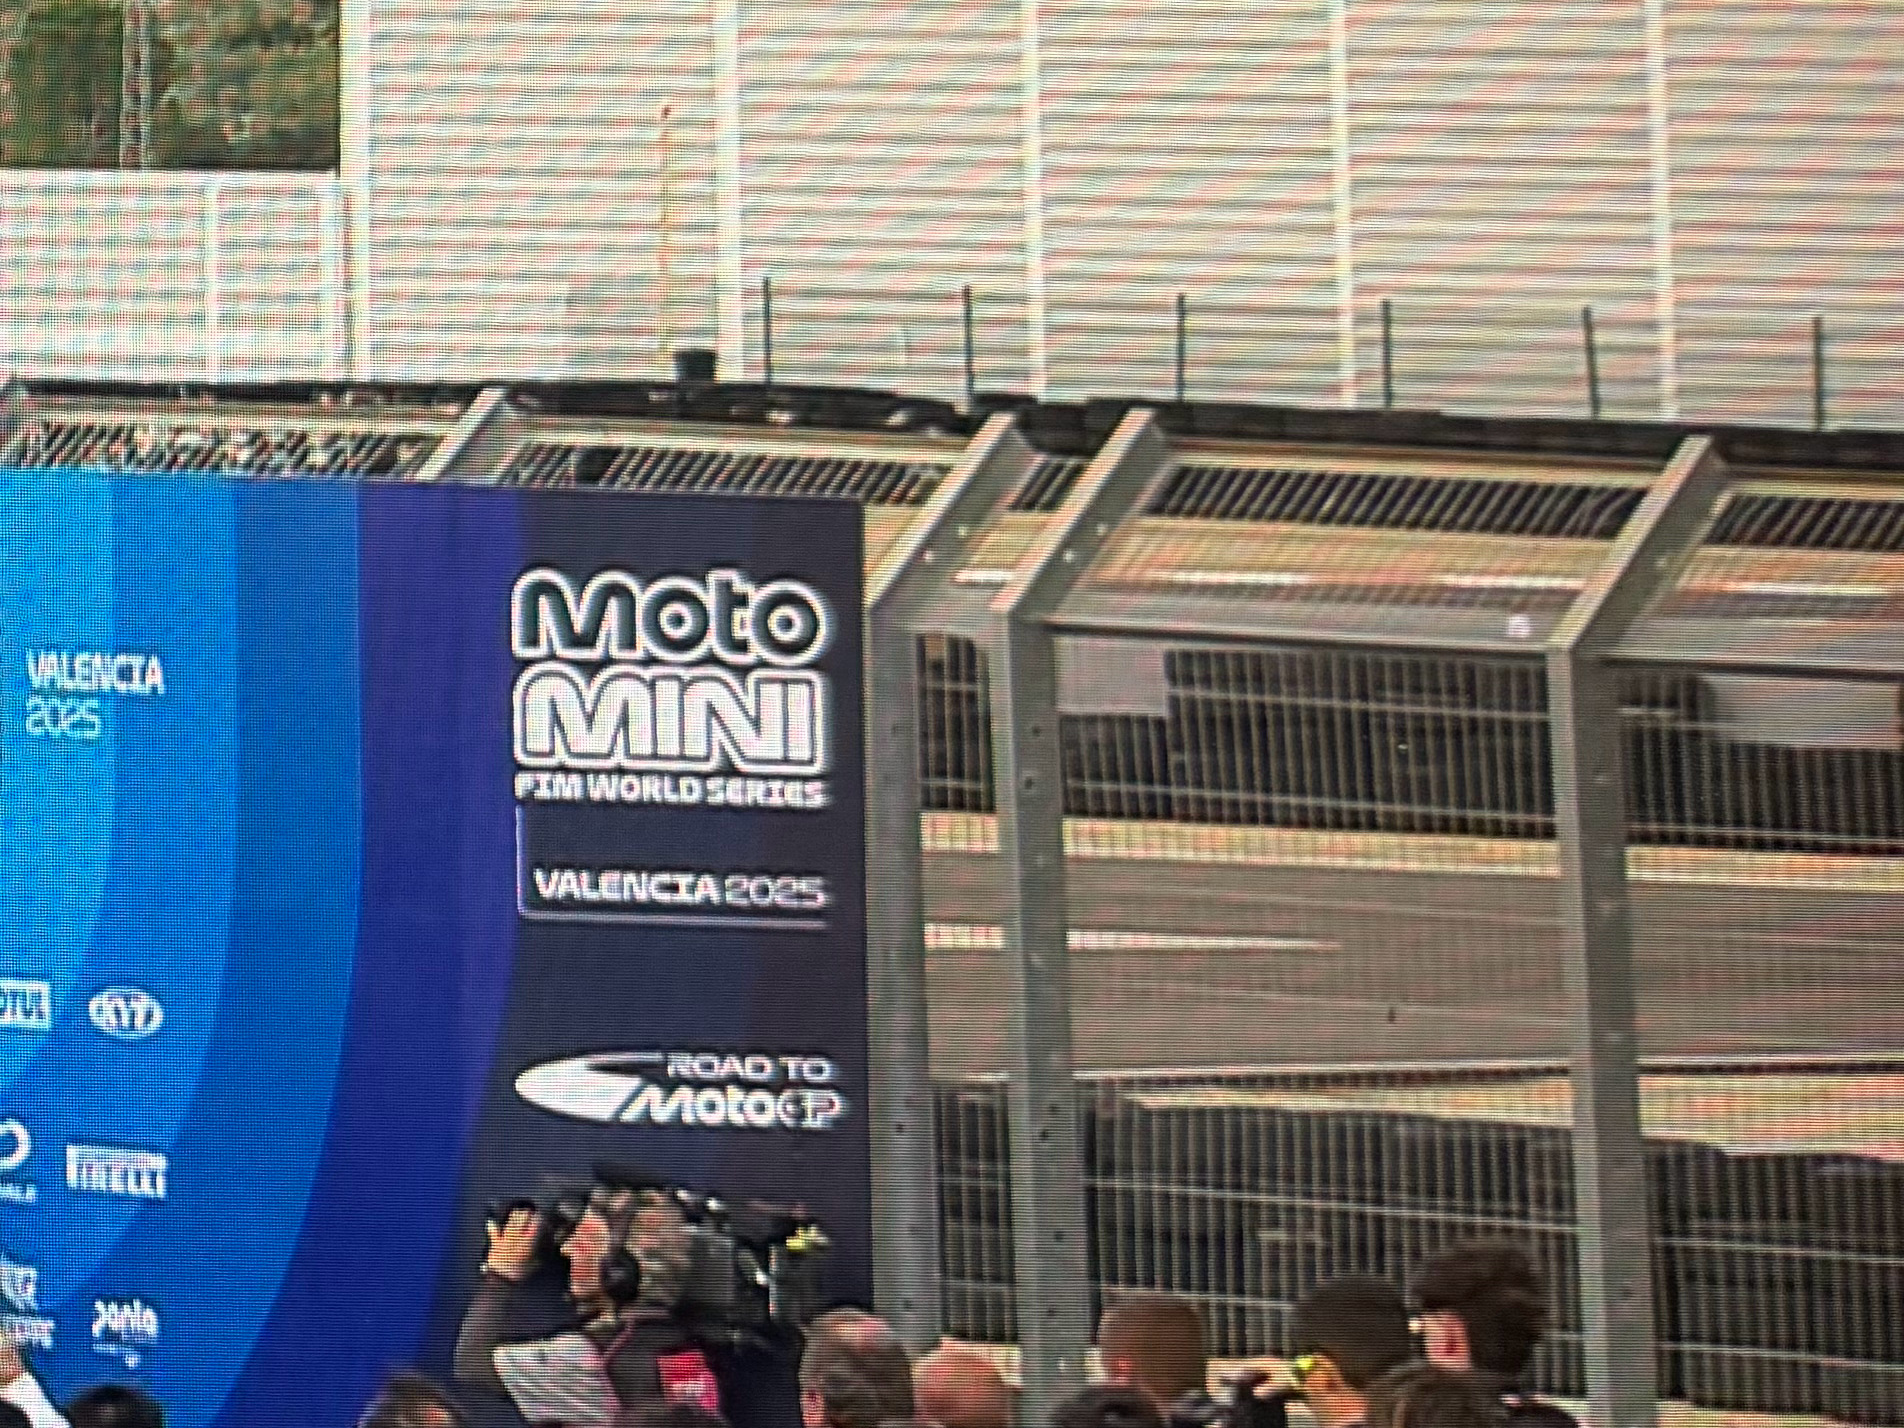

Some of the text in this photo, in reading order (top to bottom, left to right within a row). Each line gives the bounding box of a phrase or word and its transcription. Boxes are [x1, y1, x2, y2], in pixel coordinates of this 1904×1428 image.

[25, 646, 165, 697] VALENCIA
[25, 698, 102, 740] 2025
[512, 665, 830, 774] MINI
[514, 771, 828, 809] FIM WORLD SERIES
[533, 866, 829, 909] VALENCIA 2025
[667, 1052, 833, 1083] ROAD TO
